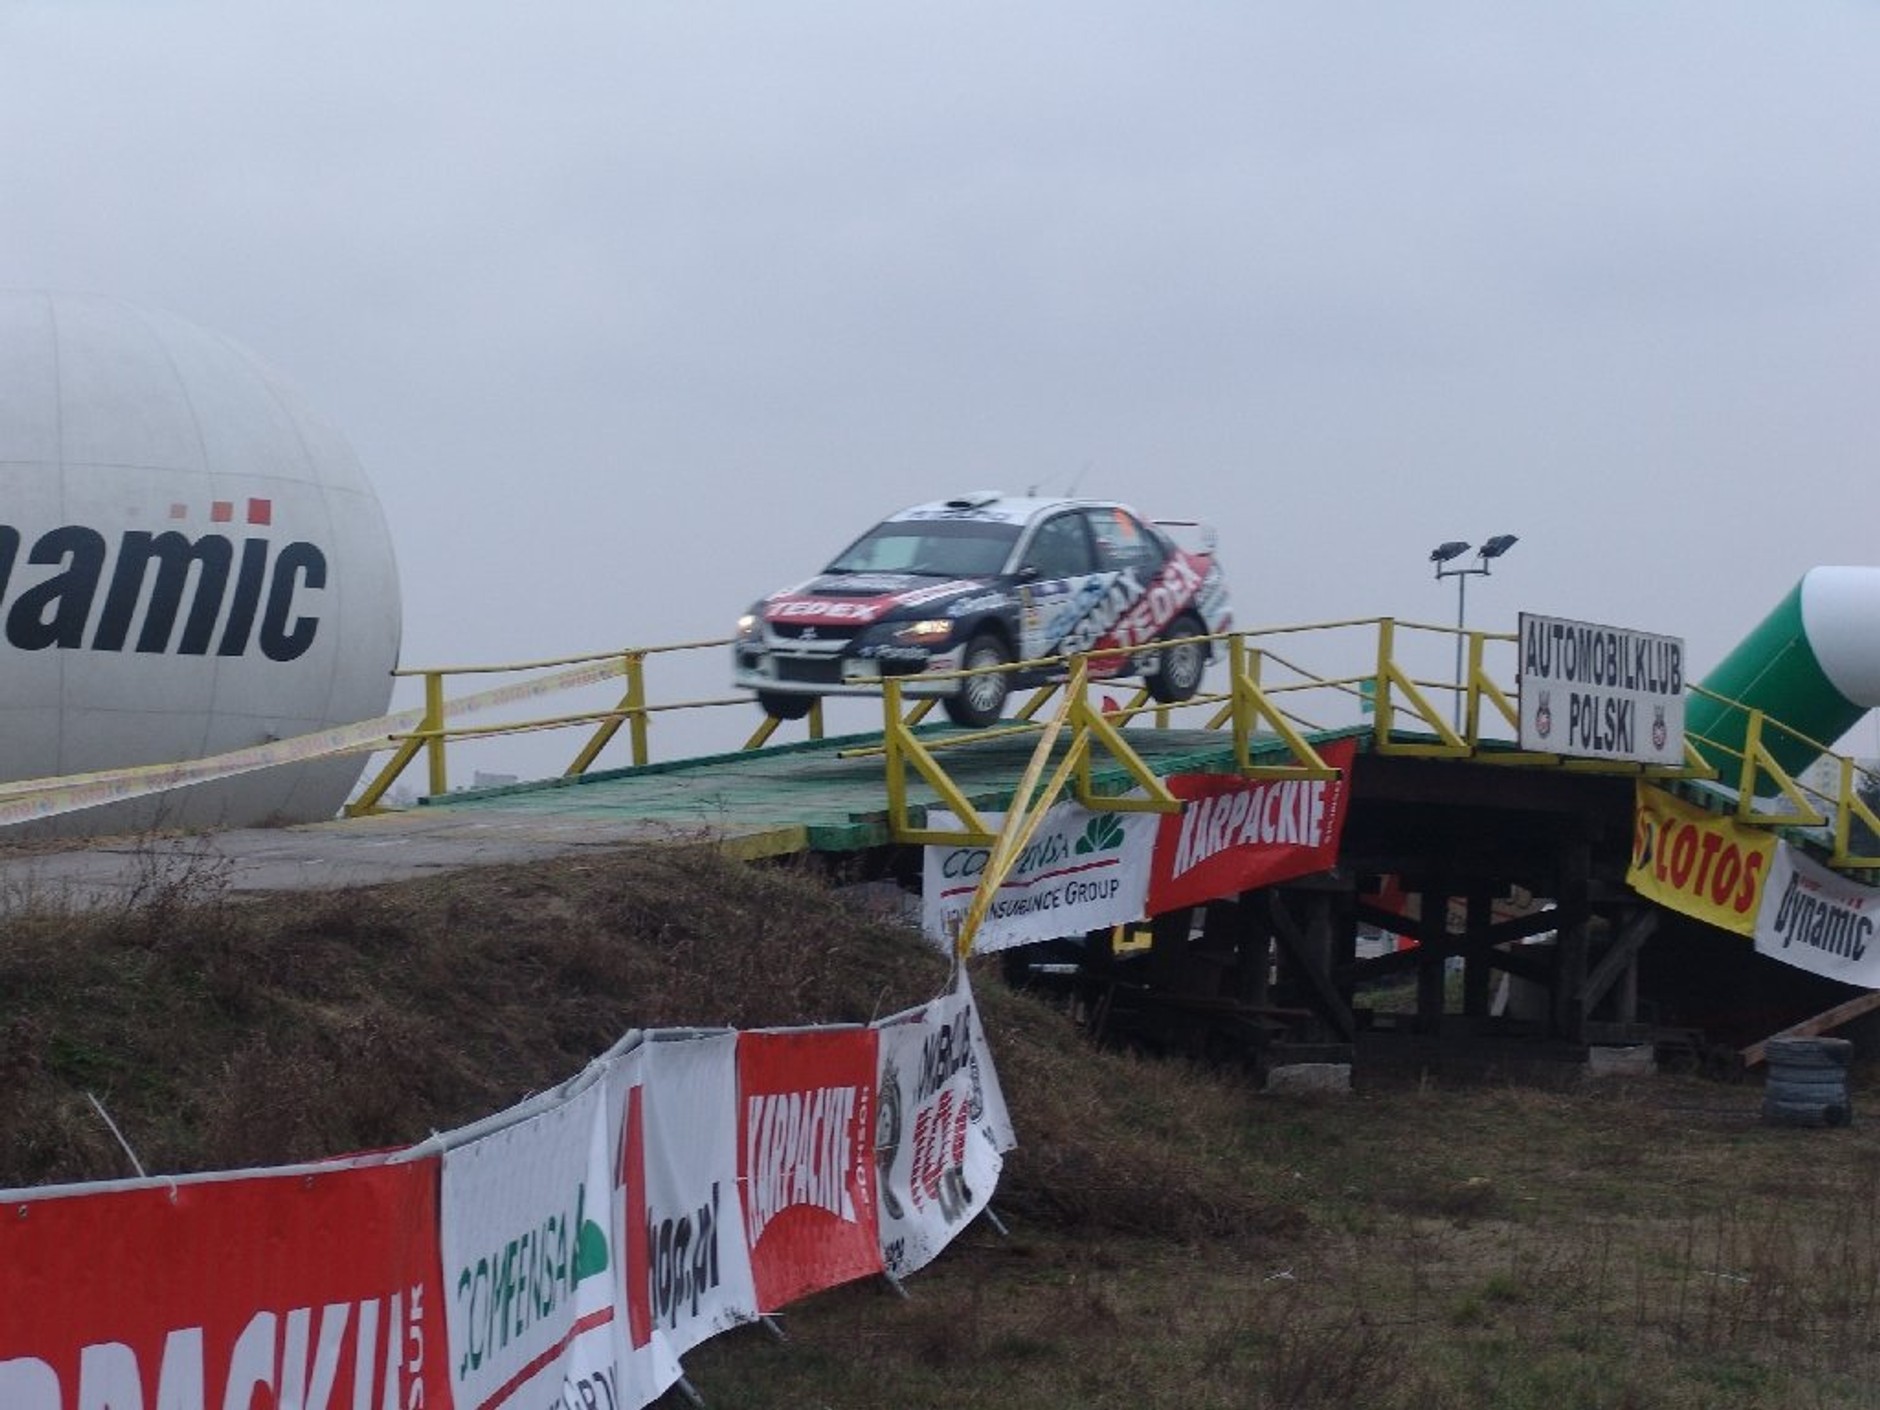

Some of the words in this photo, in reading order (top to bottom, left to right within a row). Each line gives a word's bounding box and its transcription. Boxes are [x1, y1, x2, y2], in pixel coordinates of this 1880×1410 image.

[0, 499, 326, 661] amic
[766, 600, 883, 620] TEDEX
[1525, 620, 1681, 695] AUTOMOBILKLUB
[1569, 692, 1635, 753] POLSKI
[942, 833, 1069, 878] COENSA
[1172, 780, 1326, 882] KARPACKIE
[1655, 817, 1763, 913] LOTOS
[1064, 878, 1120, 905] GROUP
[1774, 870, 1873, 961] Dynamic
[748, 1087, 858, 1250] KARPACKIE
